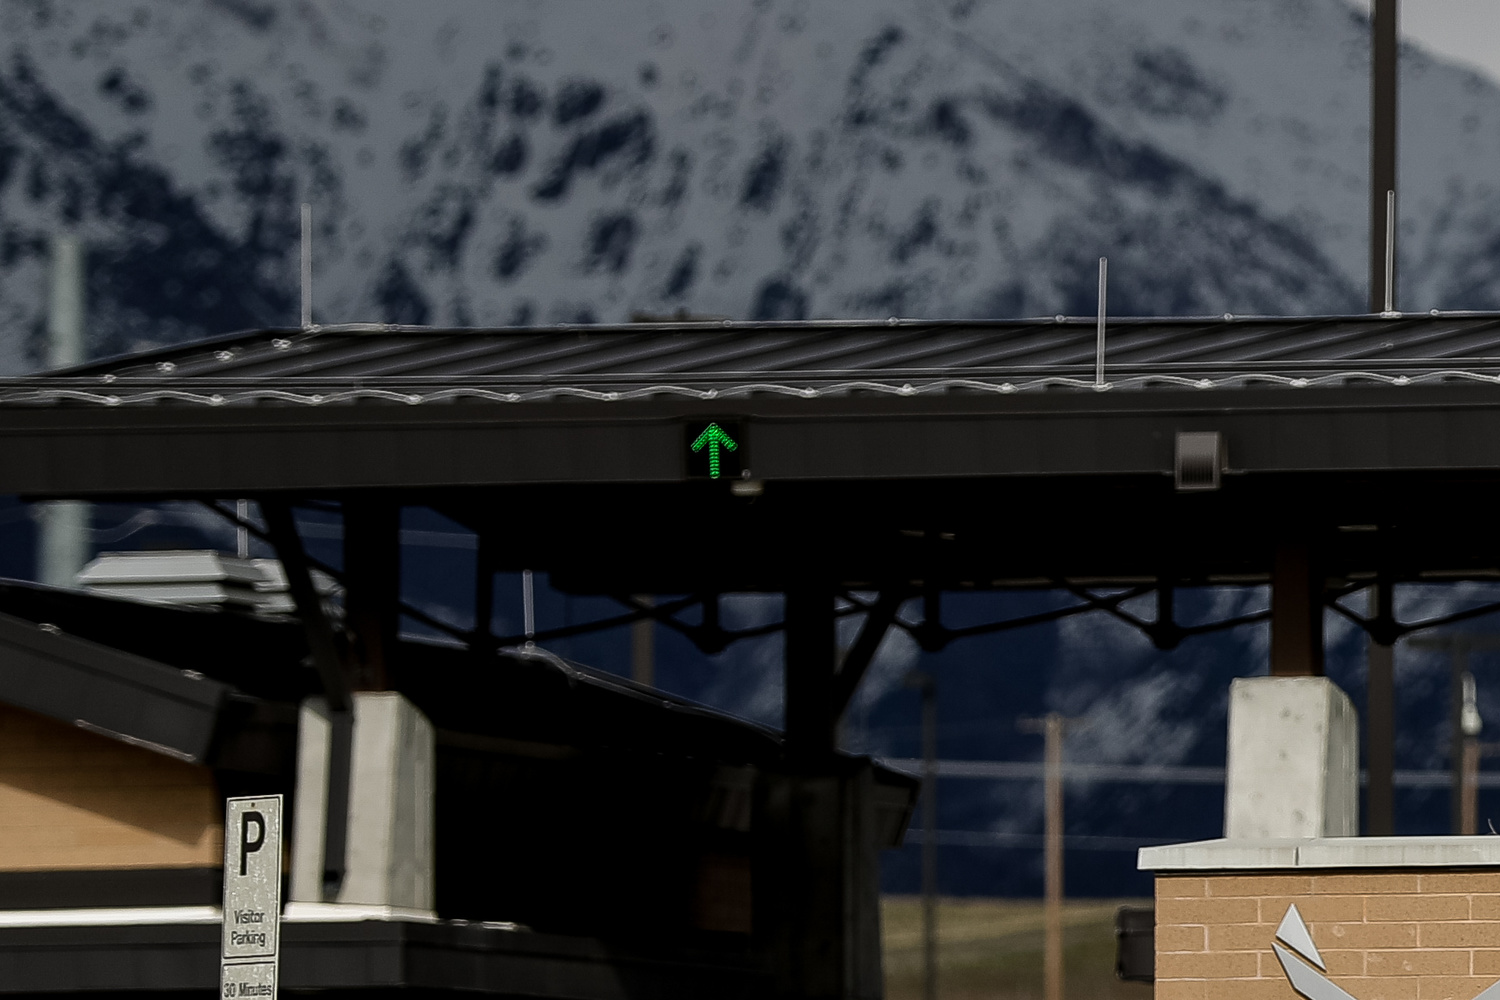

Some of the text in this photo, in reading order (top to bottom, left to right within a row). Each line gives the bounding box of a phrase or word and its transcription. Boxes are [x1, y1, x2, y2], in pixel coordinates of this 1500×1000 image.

[238, 811, 266, 876] P
[234, 910, 265, 924] Visitor
[231, 930, 266, 947] Parking
[224, 982, 272, 998] 30 Minutes
